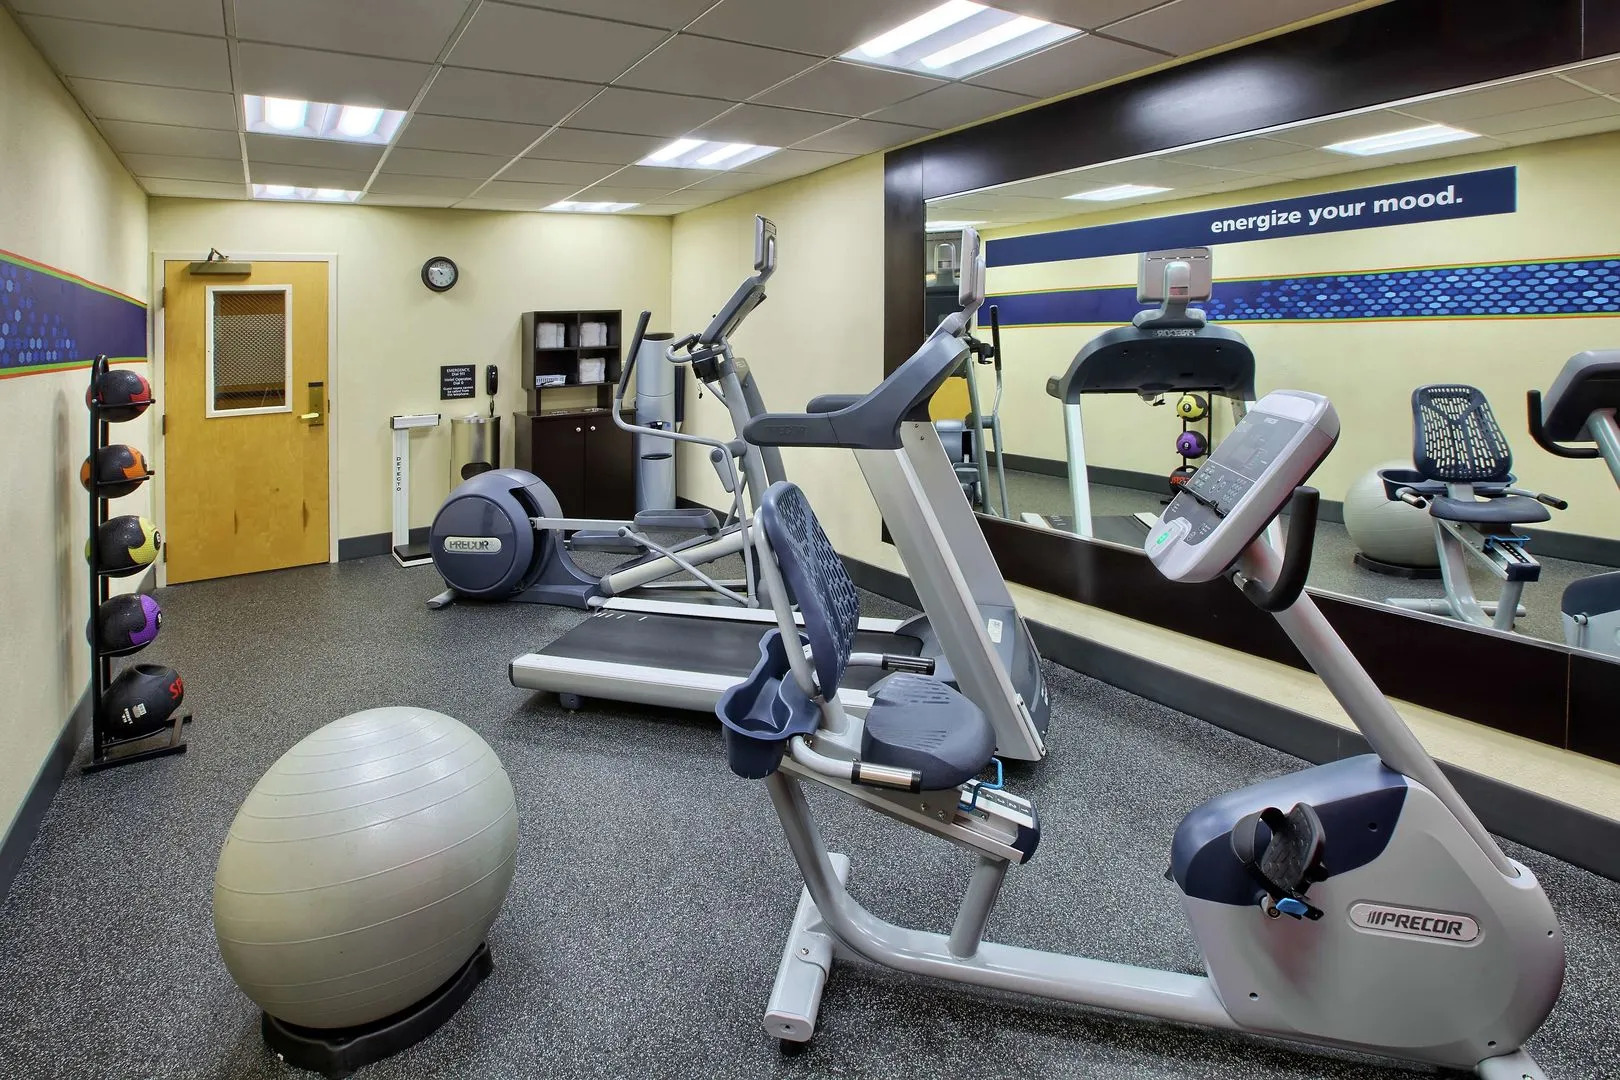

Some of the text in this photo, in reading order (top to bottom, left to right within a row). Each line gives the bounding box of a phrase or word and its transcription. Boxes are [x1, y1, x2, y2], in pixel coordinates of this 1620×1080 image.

[1211, 185, 1463, 233] energize your mood.
[449, 540, 489, 551] PRECOR
[1380, 912, 1463, 936] PRECOR
